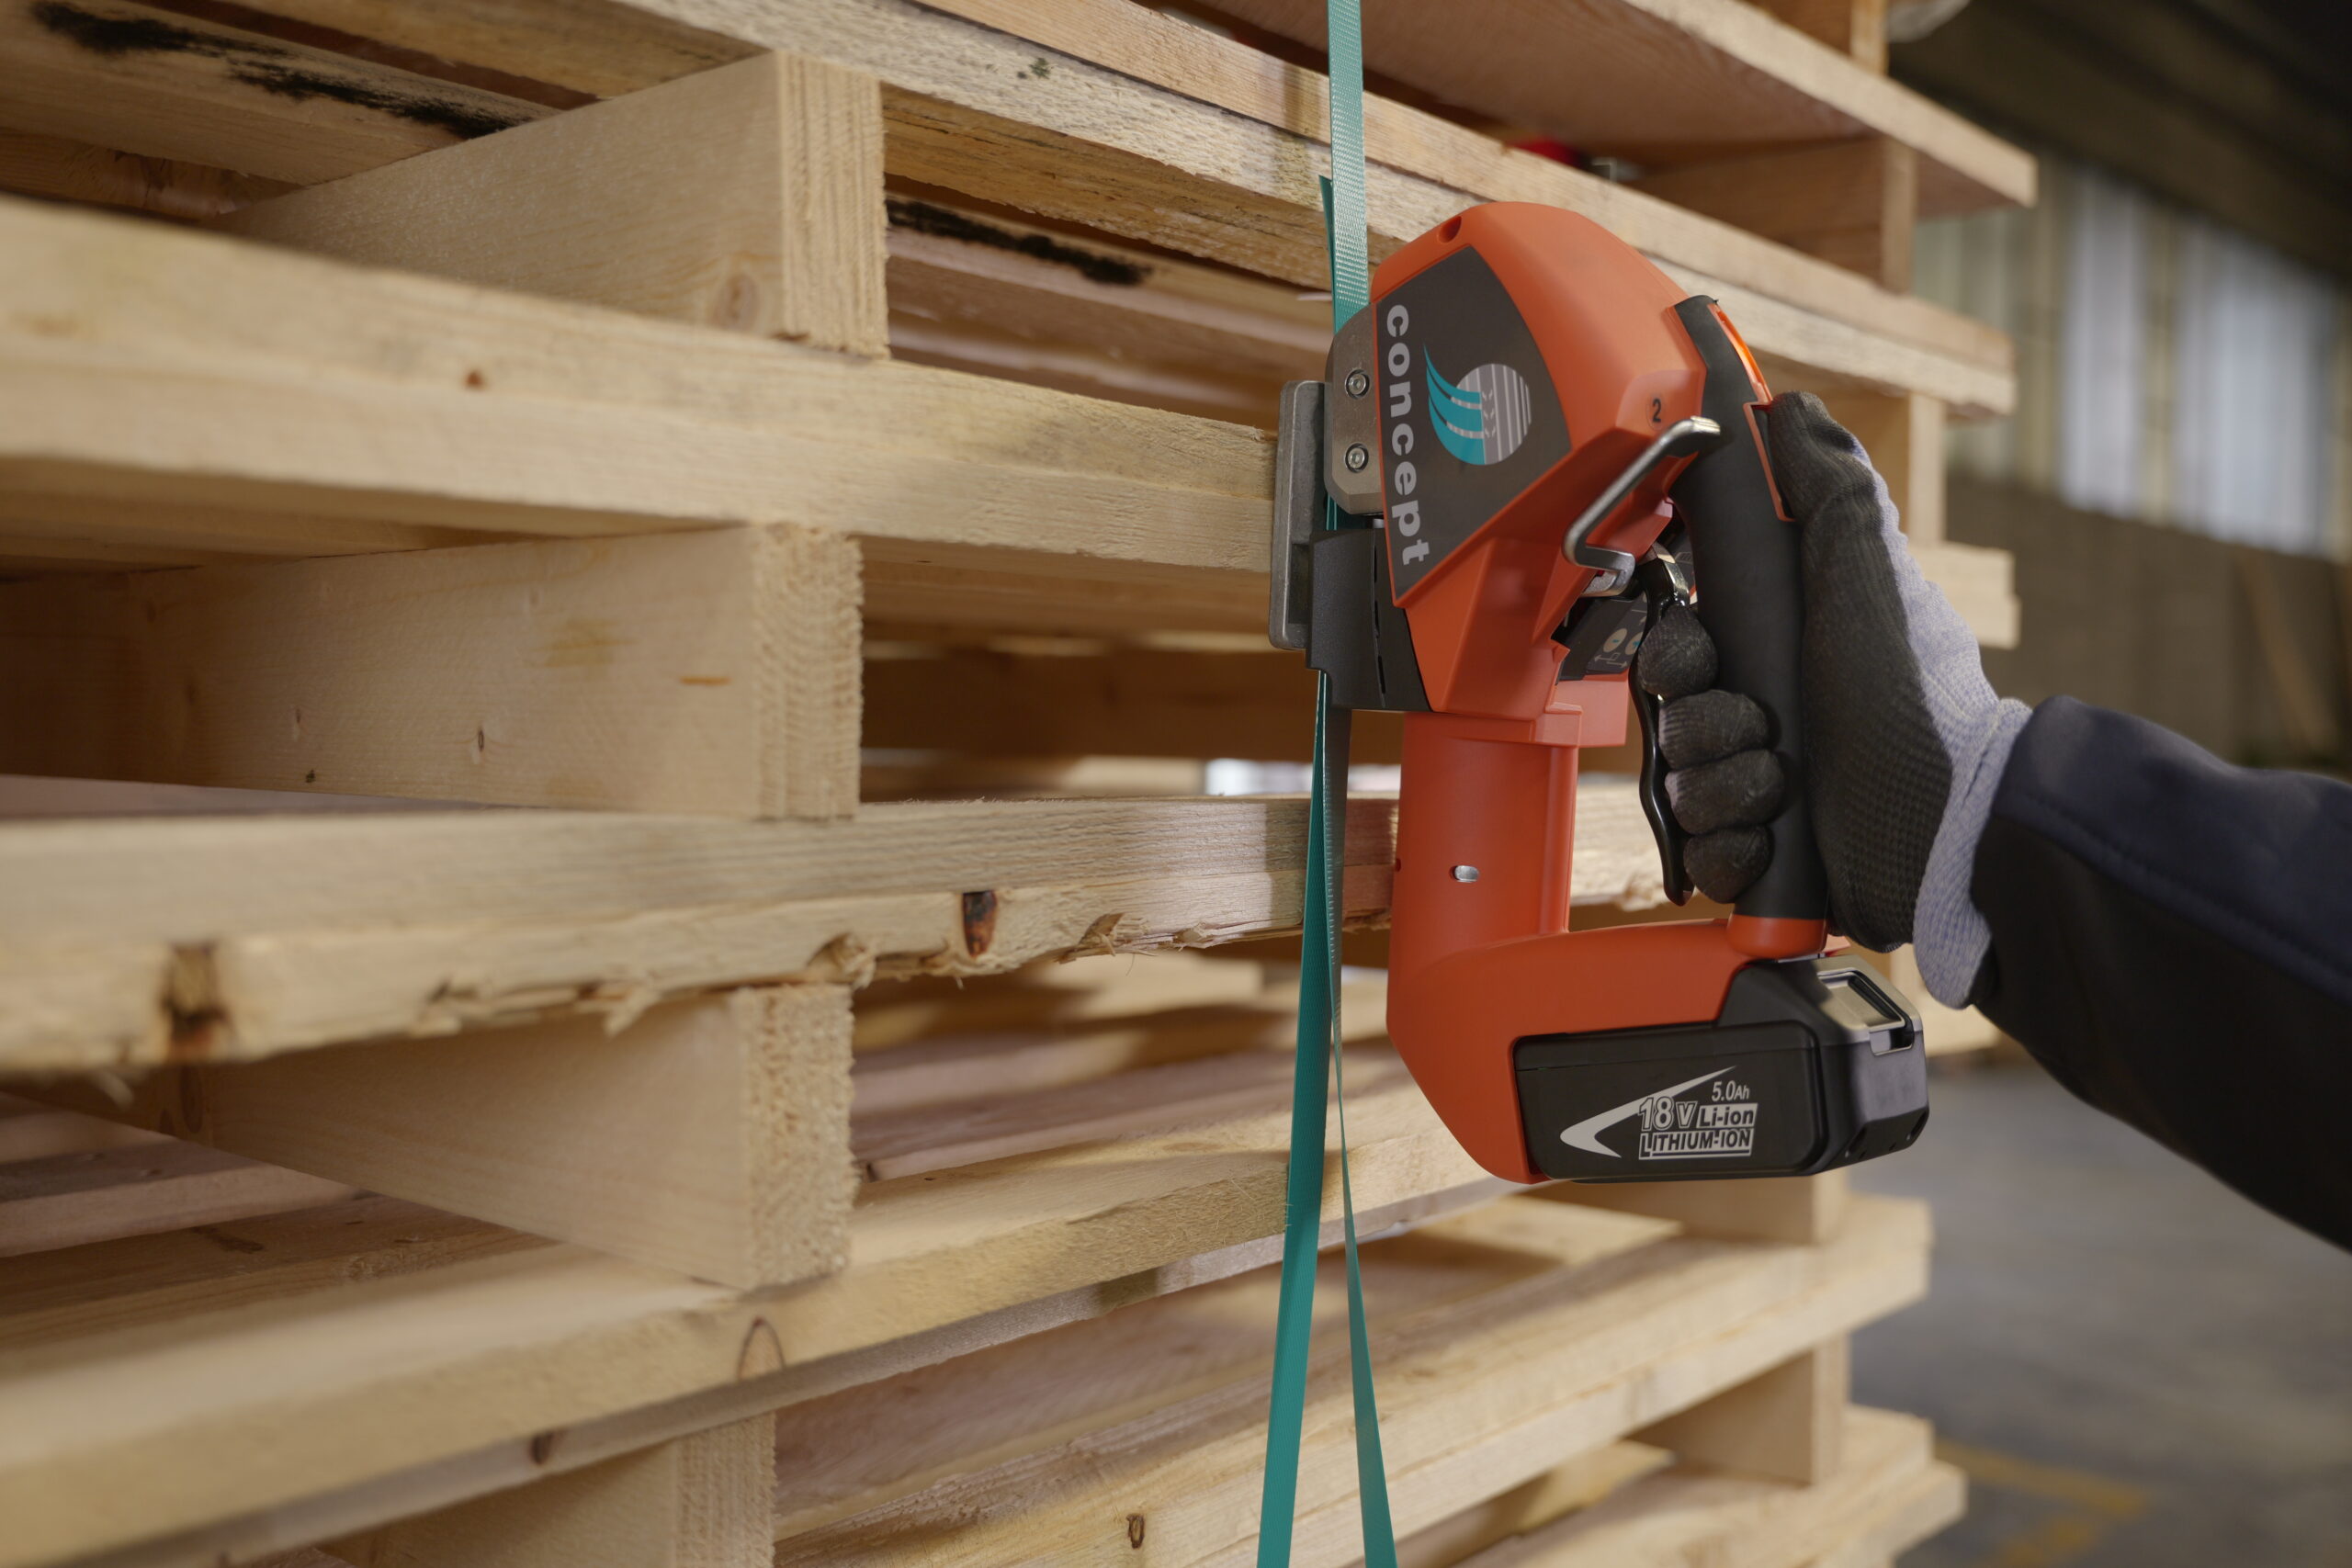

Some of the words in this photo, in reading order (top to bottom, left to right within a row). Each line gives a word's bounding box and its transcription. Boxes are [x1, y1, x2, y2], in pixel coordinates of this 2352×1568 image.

[1652, 398, 1662, 423] 2
[1386, 304, 1430, 565] concept
[1711, 1079, 1750, 1102] 5.0Ah
[1699, 1105, 1756, 1128] Li-ion
[1640, 1128, 1752, 1157] LITHIUM-ION
